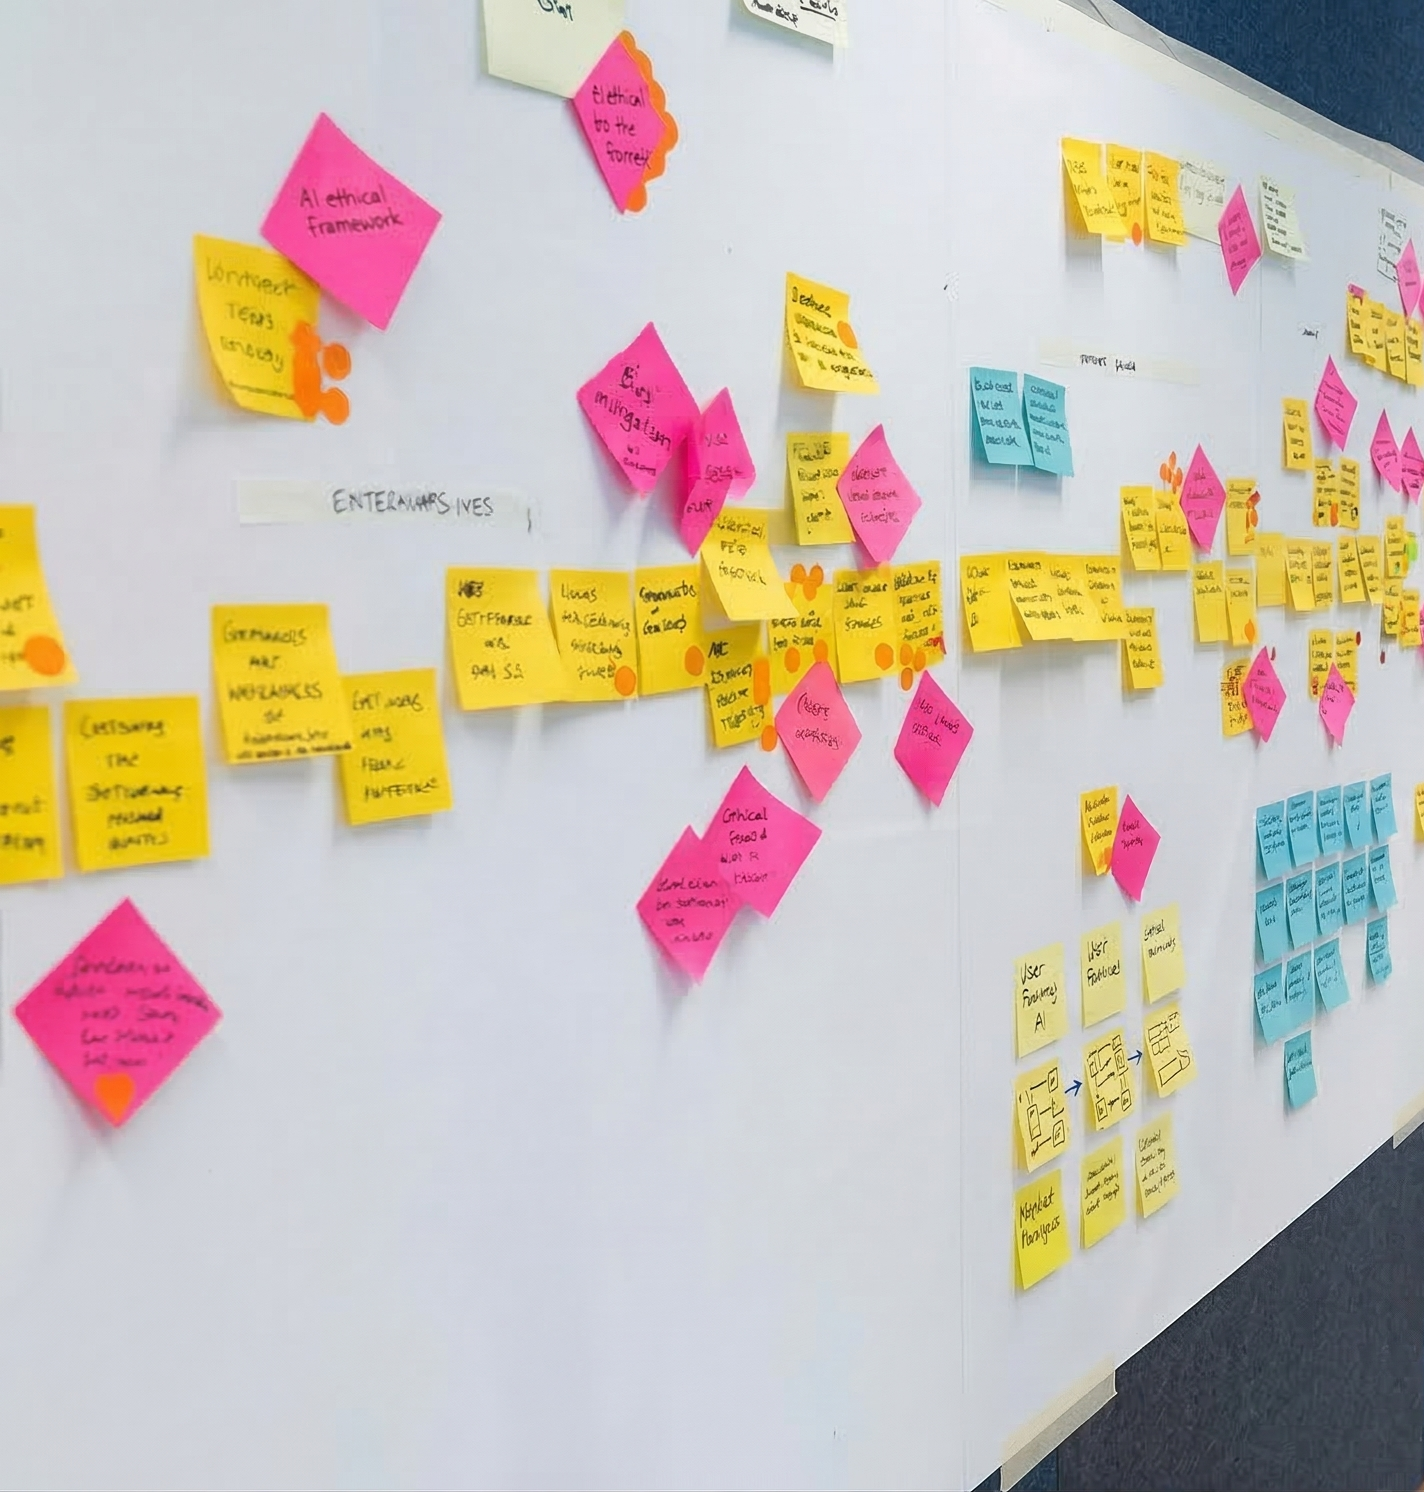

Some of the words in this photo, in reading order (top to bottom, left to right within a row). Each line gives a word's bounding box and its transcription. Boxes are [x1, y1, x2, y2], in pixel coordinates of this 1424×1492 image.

[326, 184, 387, 208] ethical
[308, 207, 404, 238] framework
[1021, 962, 1045, 985] User
